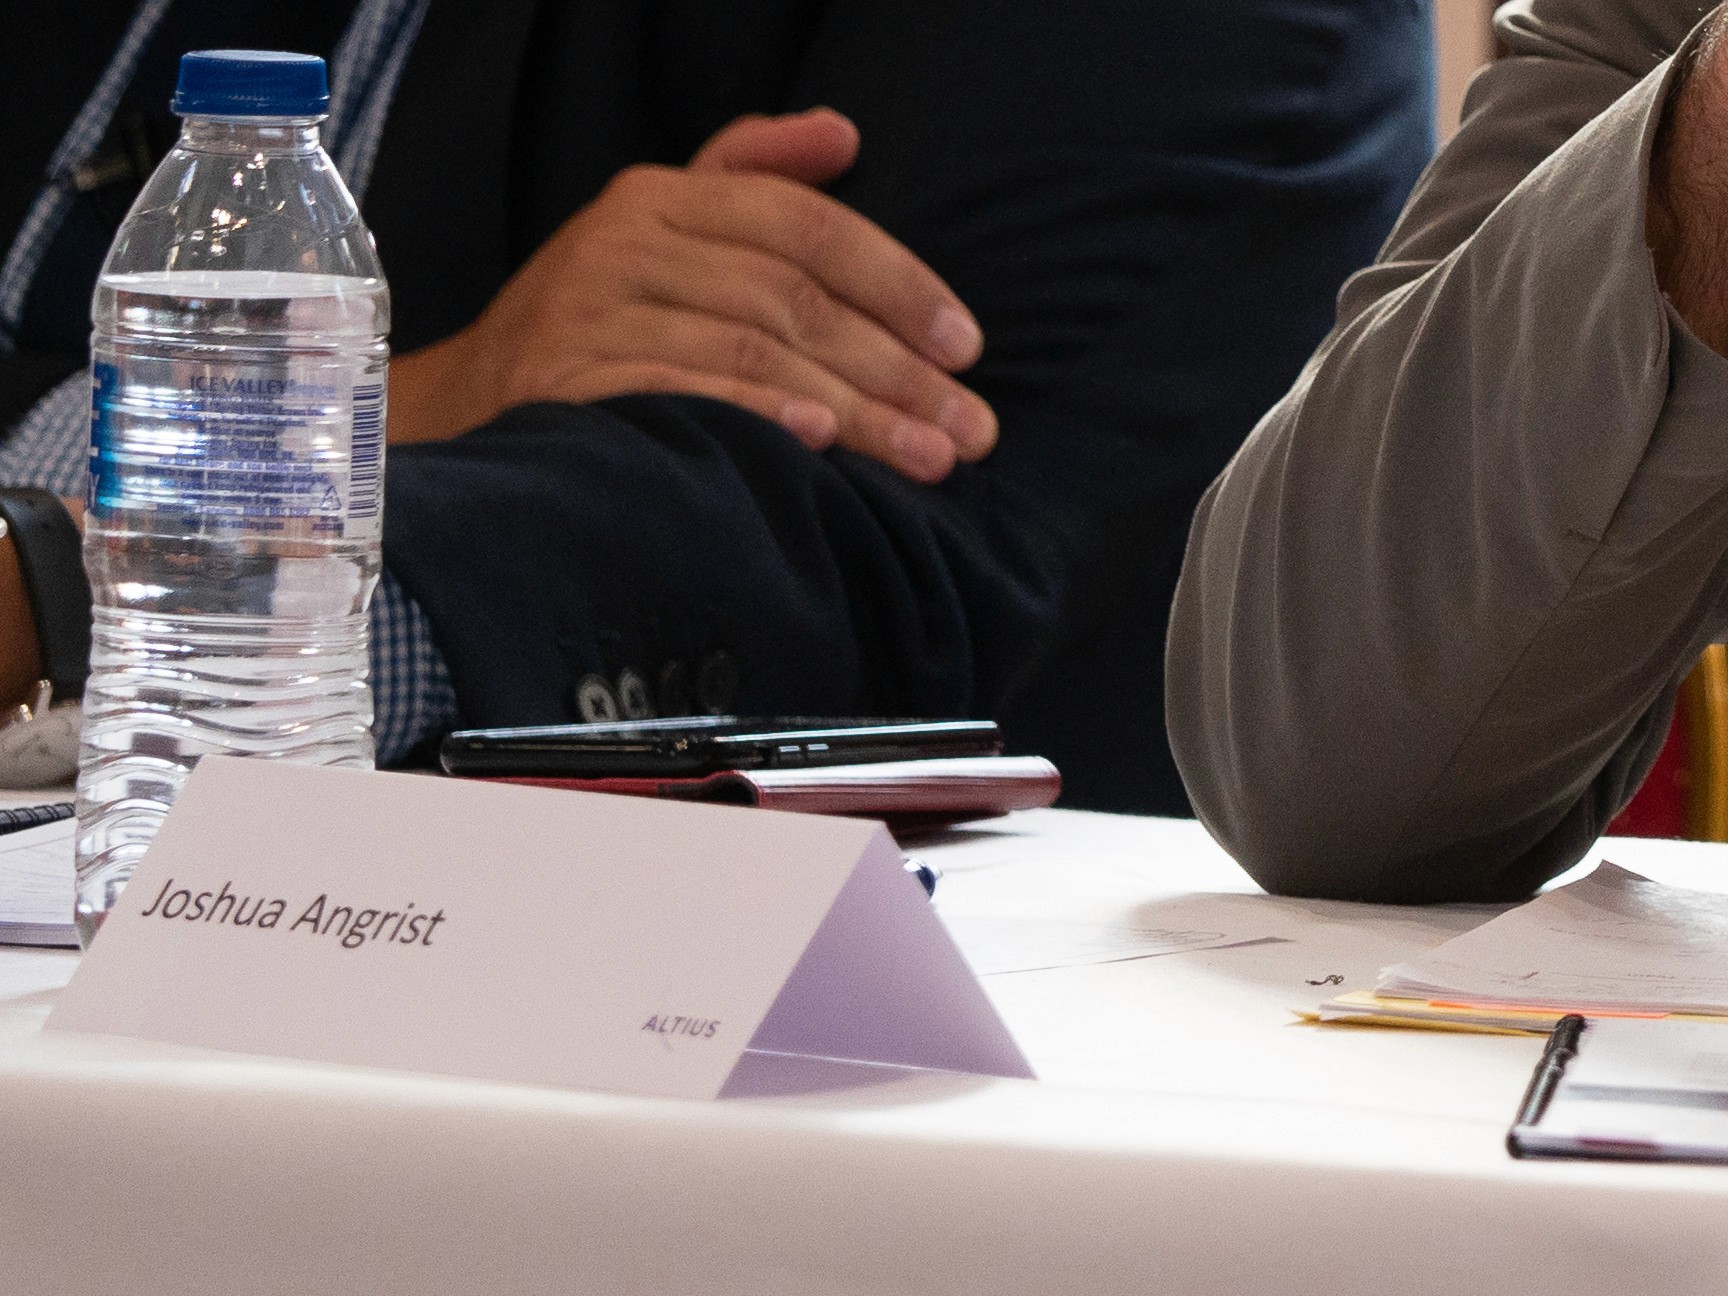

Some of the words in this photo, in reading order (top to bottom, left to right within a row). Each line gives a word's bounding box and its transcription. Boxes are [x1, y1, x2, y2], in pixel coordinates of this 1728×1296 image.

[141, 878, 287, 929] Joshua
[289, 892, 447, 949] Angrist
[641, 1014, 721, 1038] ALTIUS
